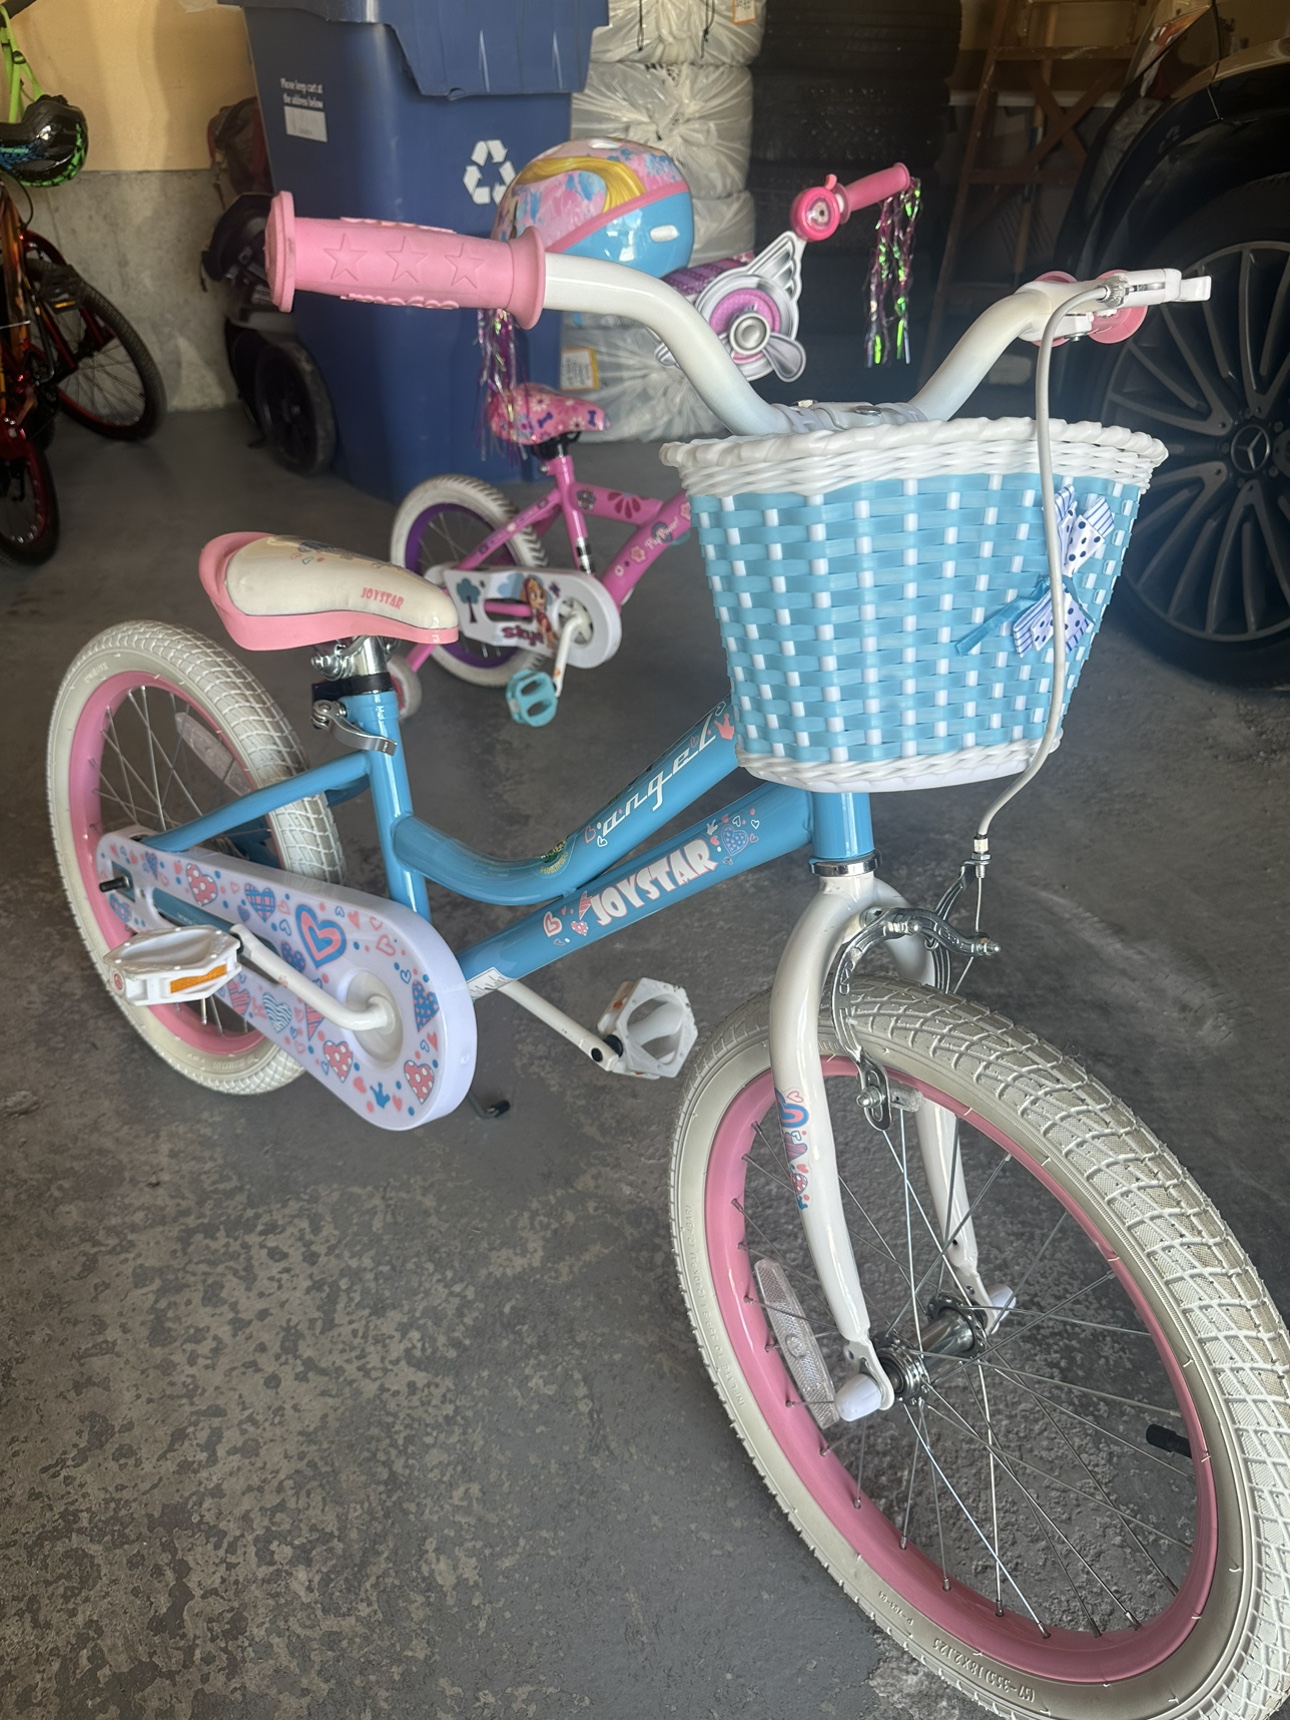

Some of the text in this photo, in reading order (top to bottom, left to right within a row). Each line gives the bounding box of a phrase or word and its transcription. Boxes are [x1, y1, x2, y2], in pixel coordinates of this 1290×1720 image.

[360, 586, 405, 610] JOYSTAR
[590, 838, 719, 927] JOYSTAR
[720, 1363, 745, 1407] INFLATE
